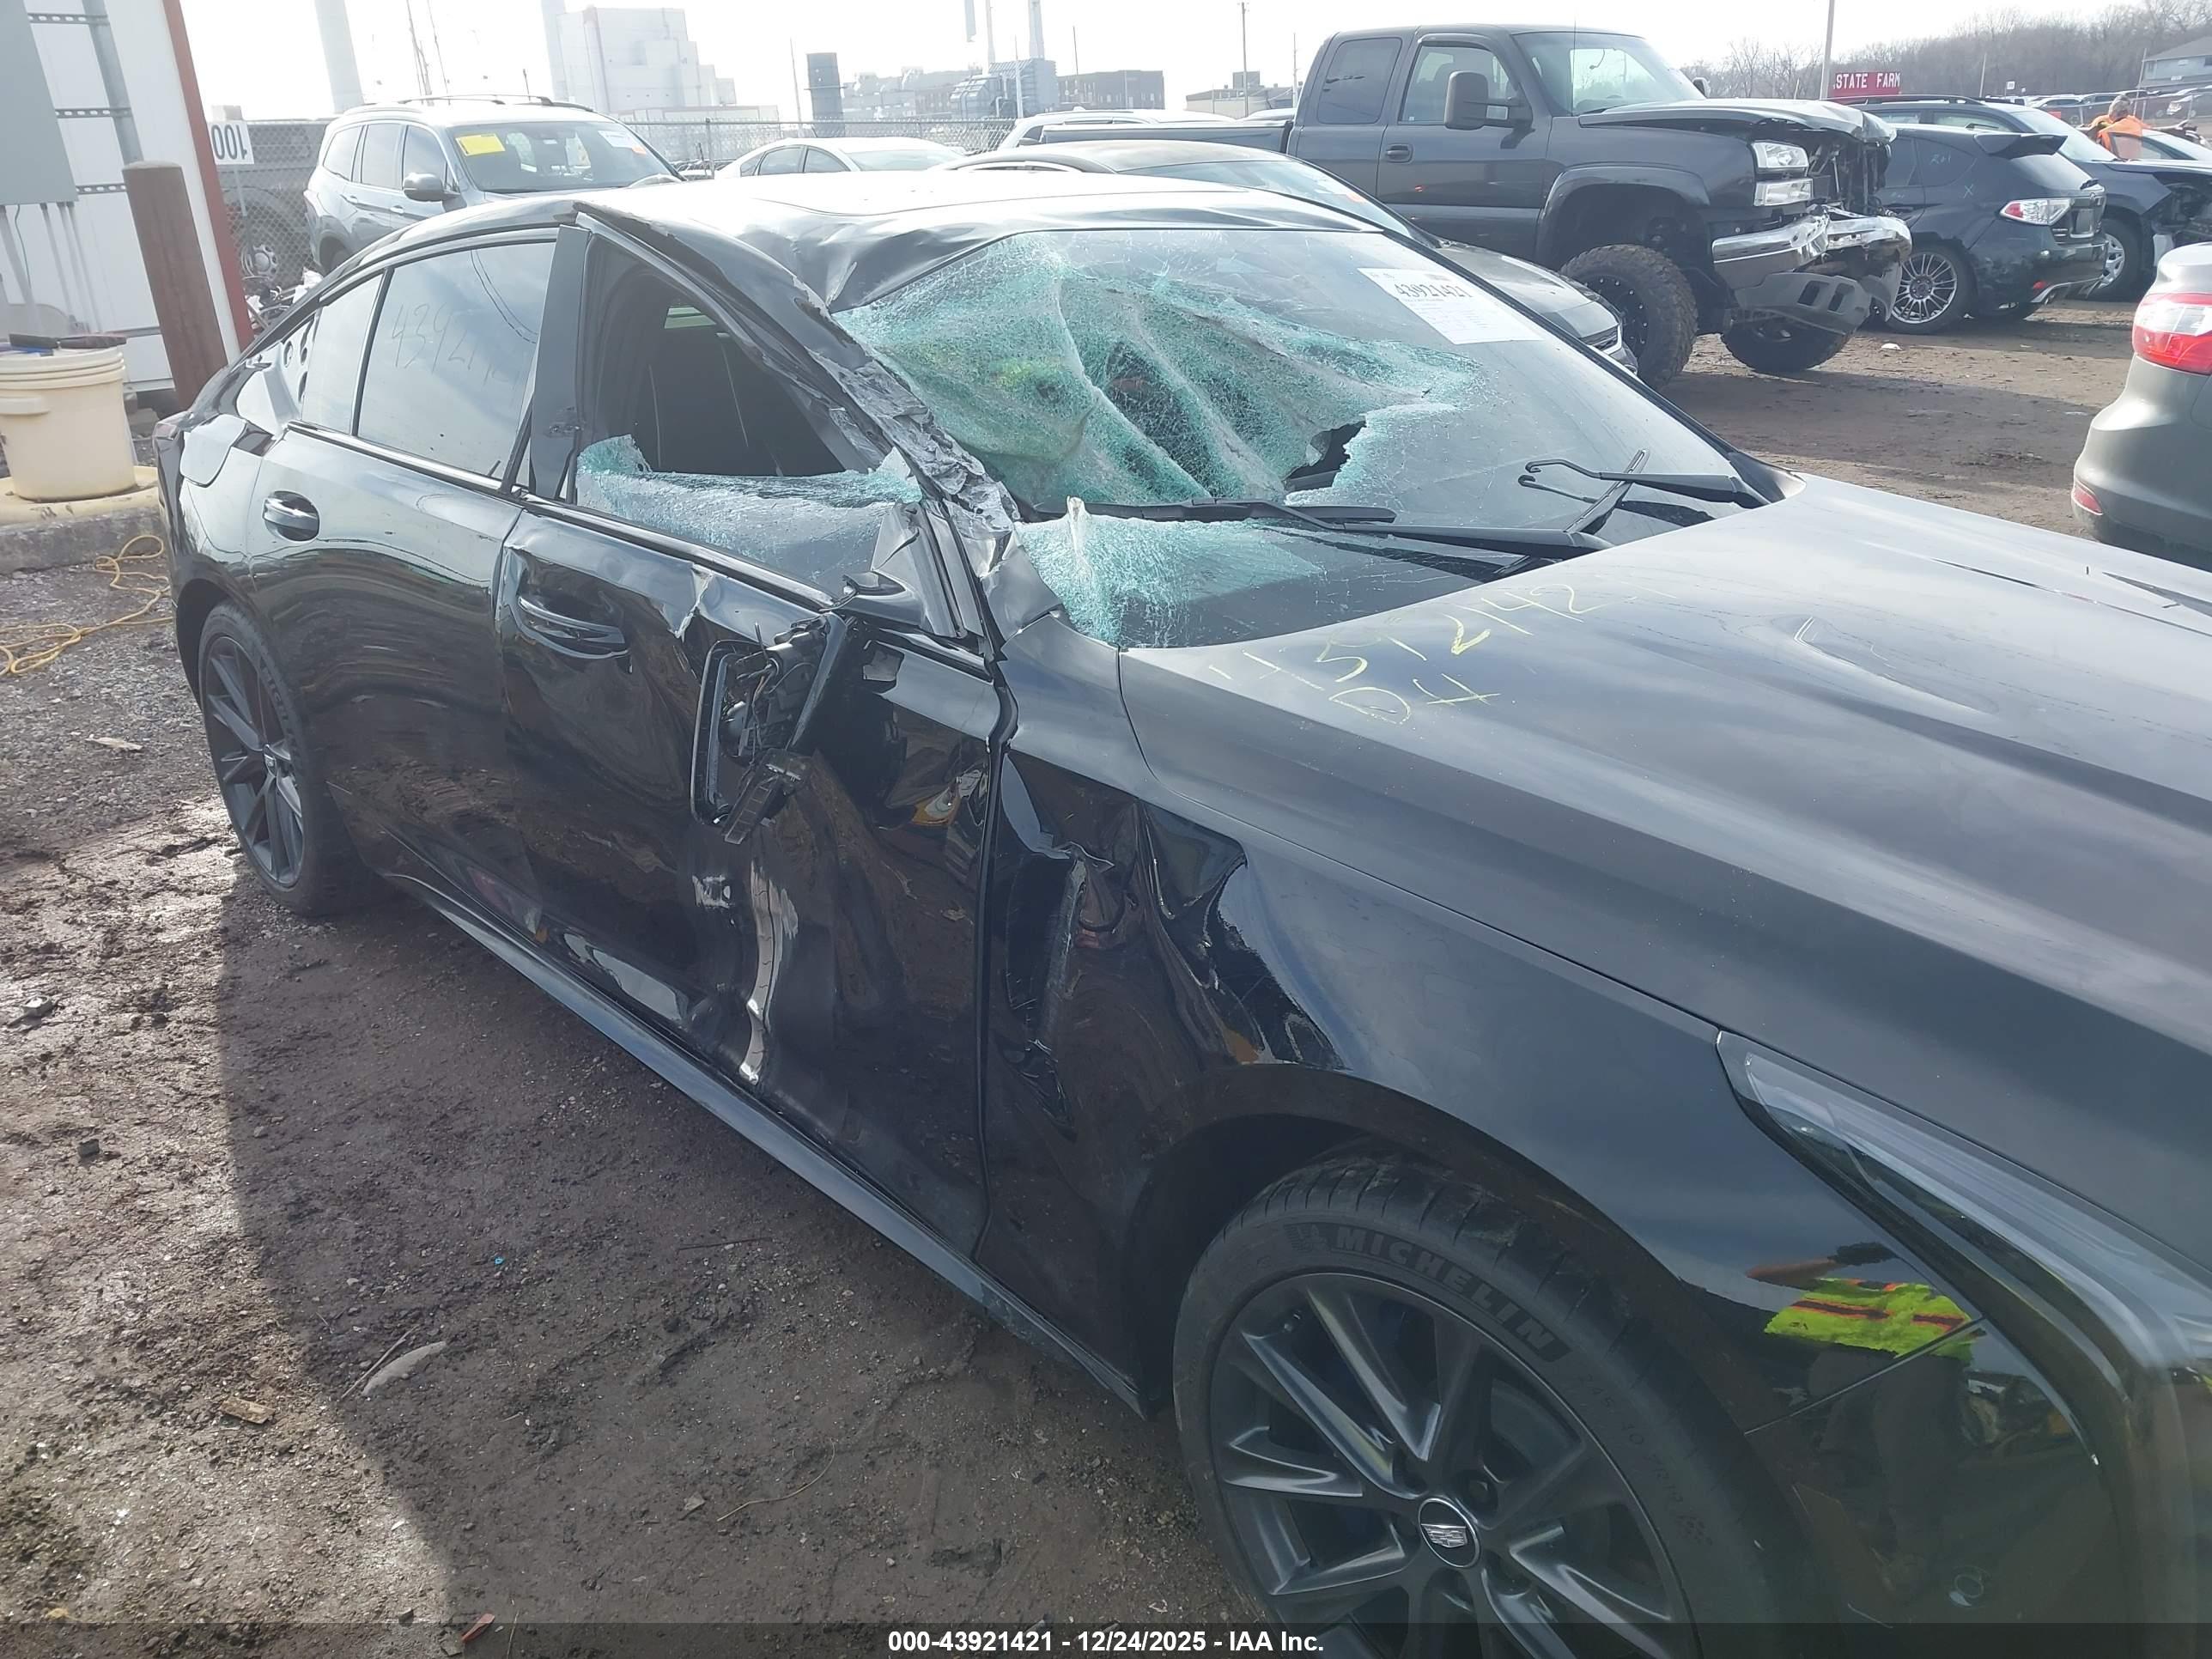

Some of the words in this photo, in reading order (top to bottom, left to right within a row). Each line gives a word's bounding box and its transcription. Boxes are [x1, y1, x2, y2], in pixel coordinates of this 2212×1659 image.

[1836, 73, 1868, 89] STATE
[1876, 72, 1901, 88] FARM
[211, 125, 247, 160] 100
[1394, 283, 1474, 298] 43921421
[1336, 1226, 1556, 1351] MICHELIN
